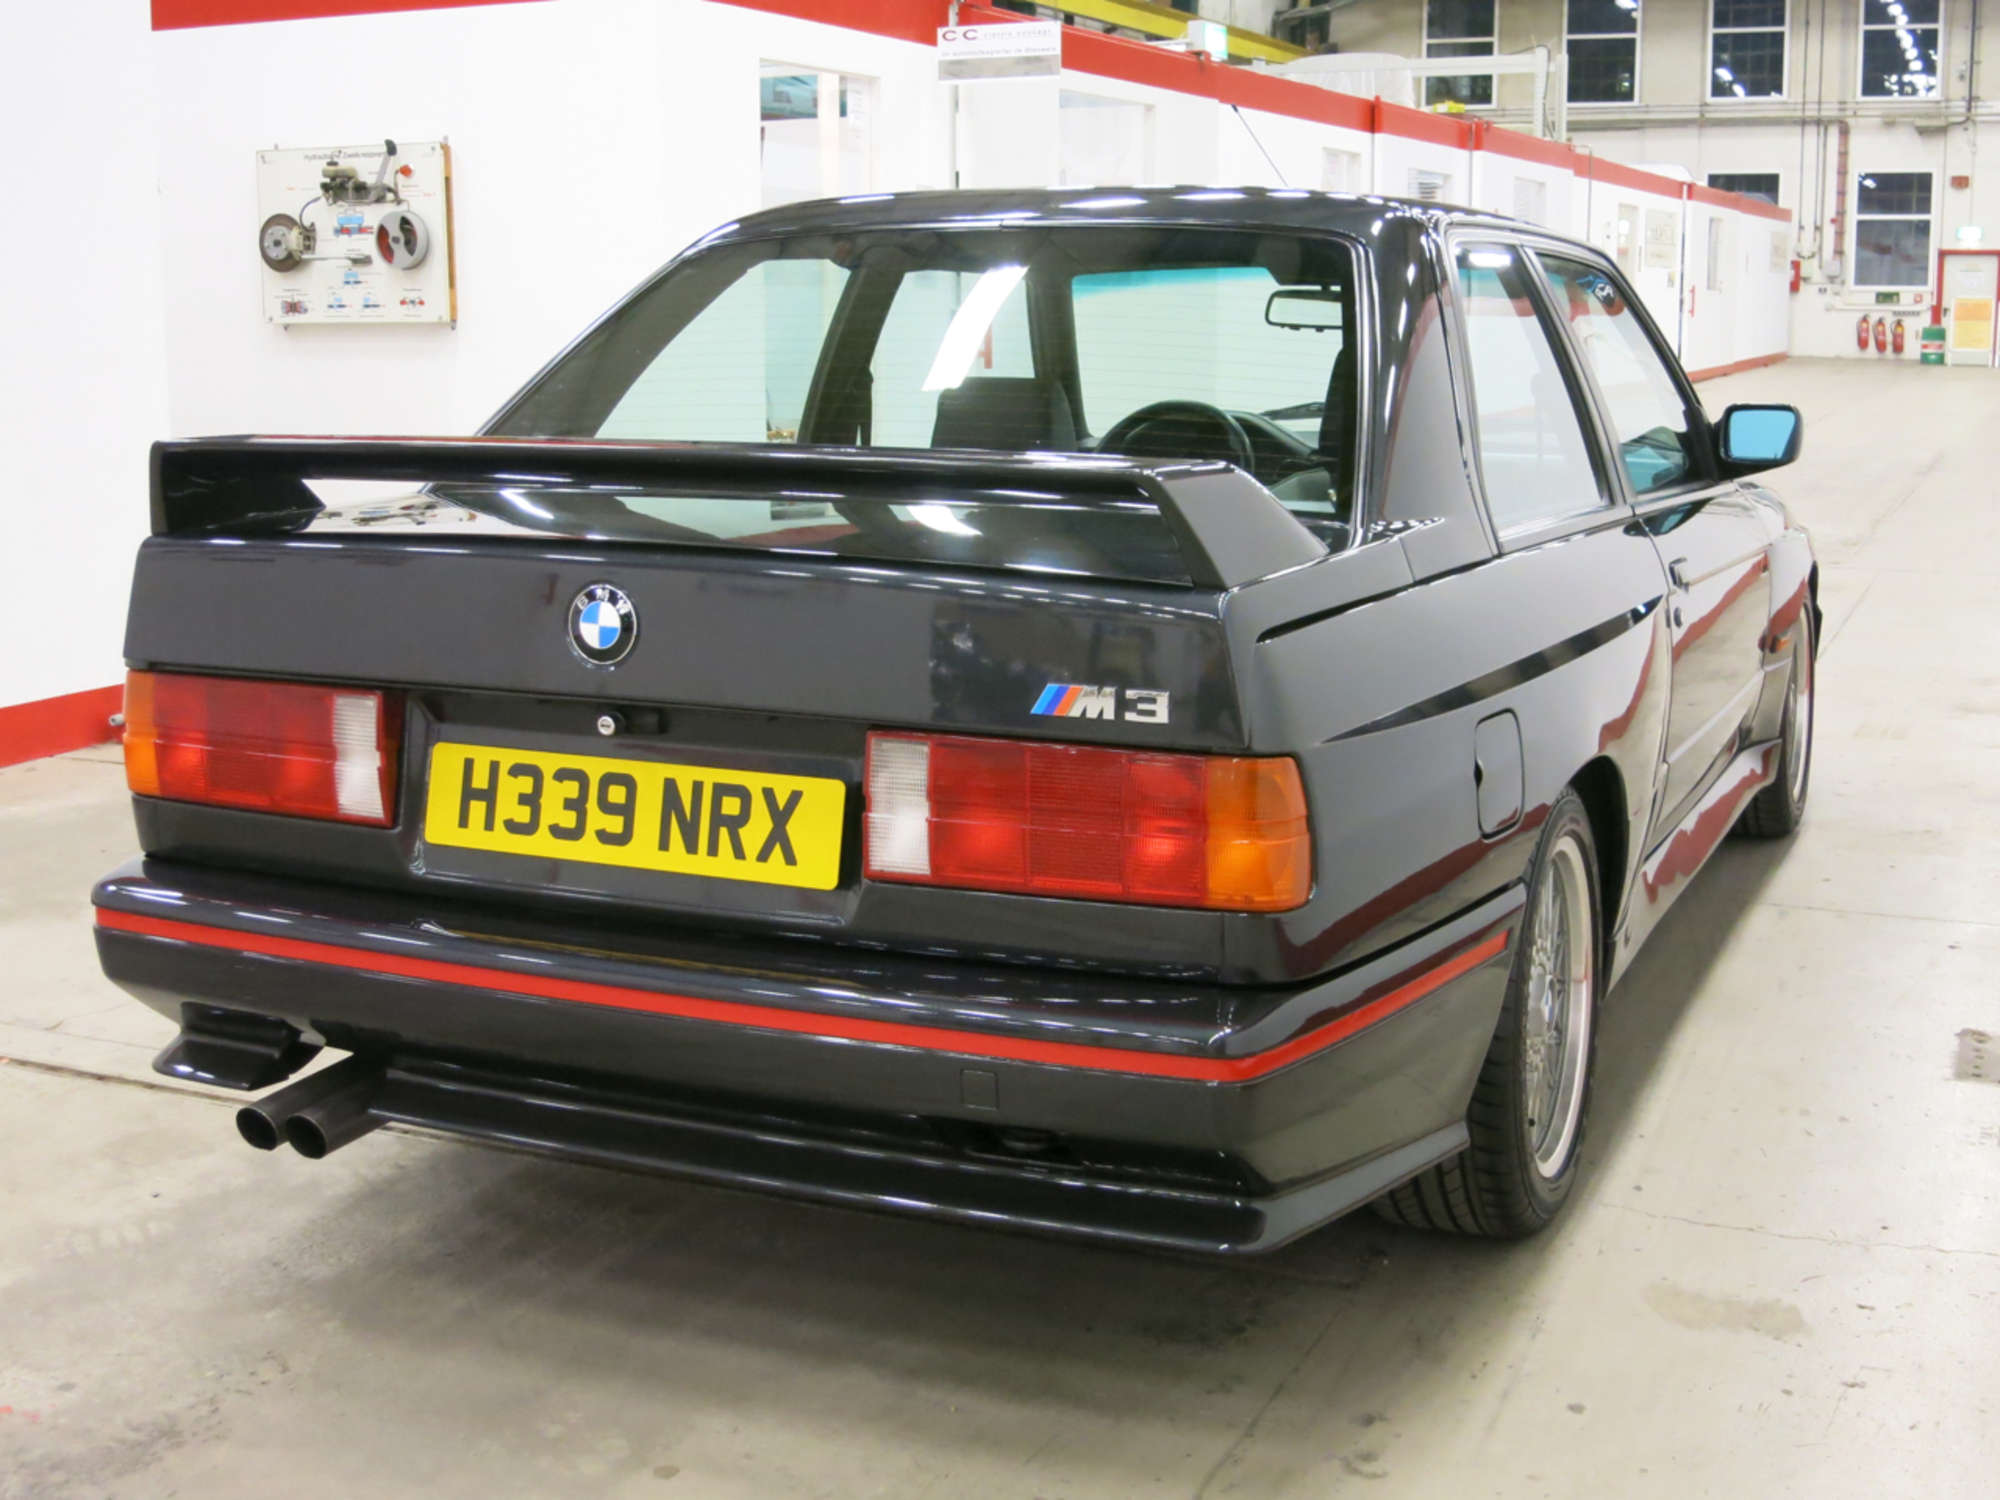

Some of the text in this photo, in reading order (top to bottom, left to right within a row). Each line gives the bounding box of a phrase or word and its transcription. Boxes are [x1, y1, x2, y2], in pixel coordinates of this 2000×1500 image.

[576, 588, 632, 616] BMW
[1068, 685, 1170, 723] M3
[458, 757, 804, 867] H339 NRX
